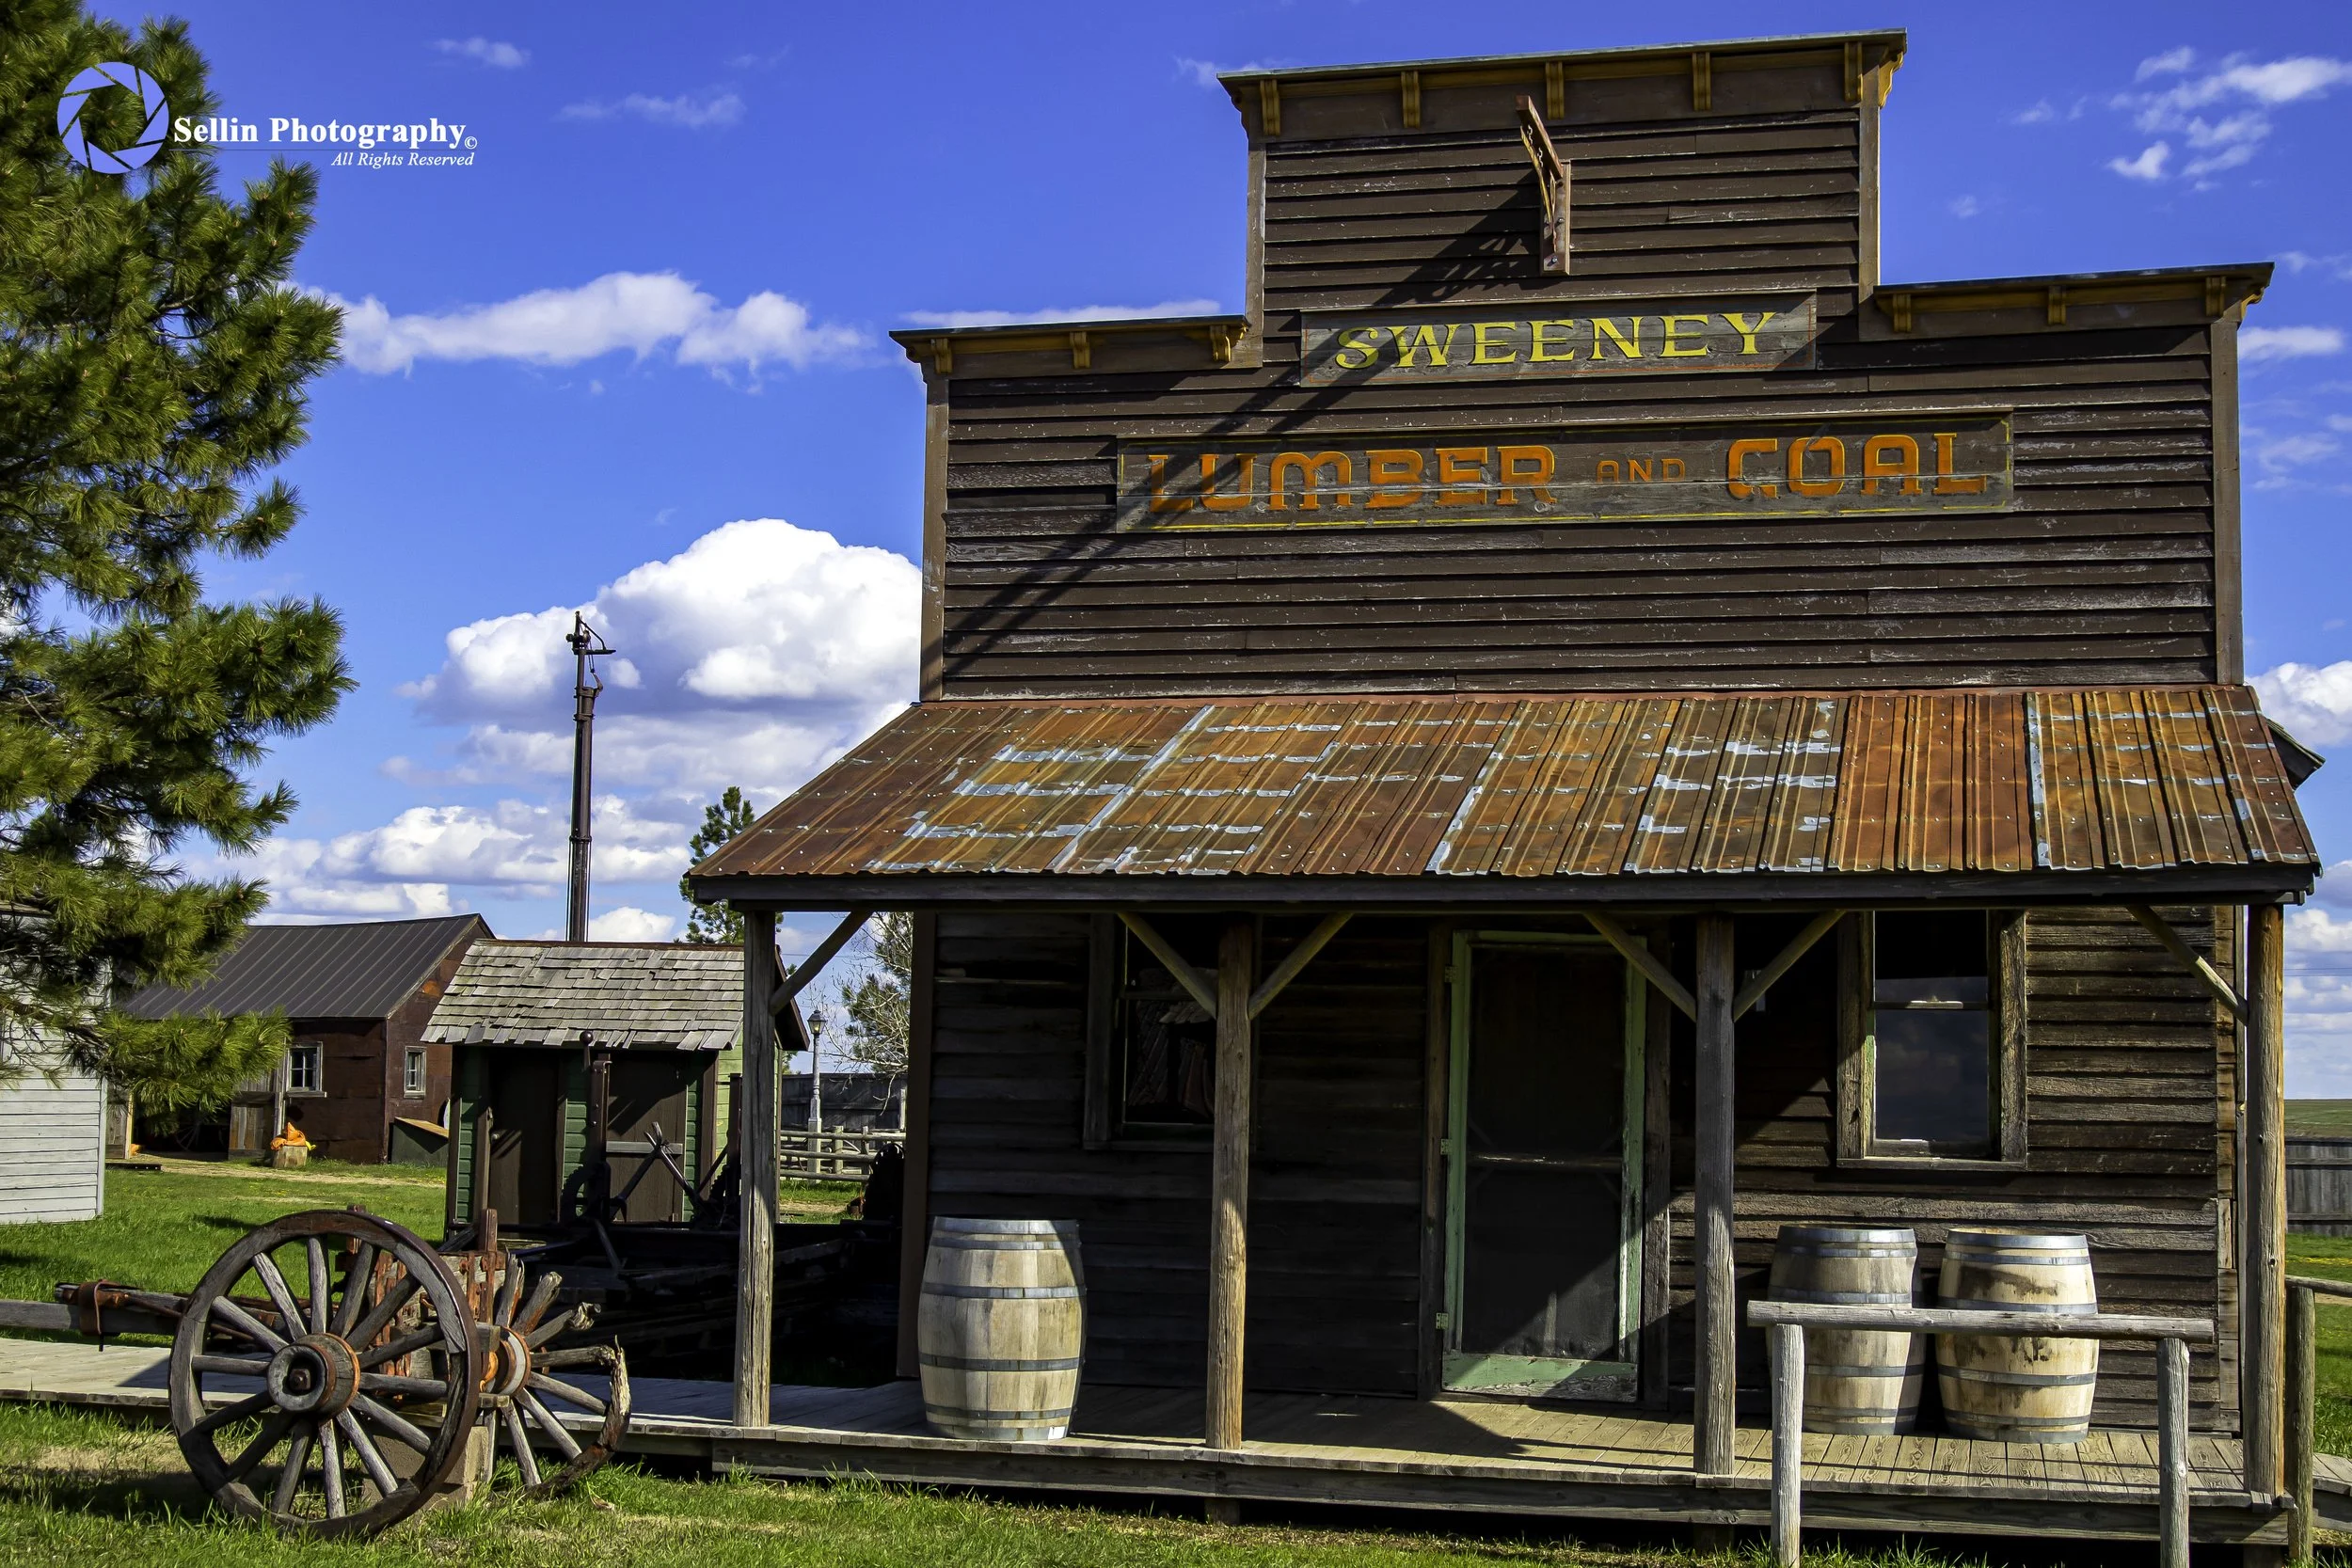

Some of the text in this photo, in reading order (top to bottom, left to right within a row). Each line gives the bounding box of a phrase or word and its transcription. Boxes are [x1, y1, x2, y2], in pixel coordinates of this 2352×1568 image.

[1334, 311, 1776, 370] SWEENEY
[1147, 433, 1987, 513] LUMBER AND COAL
